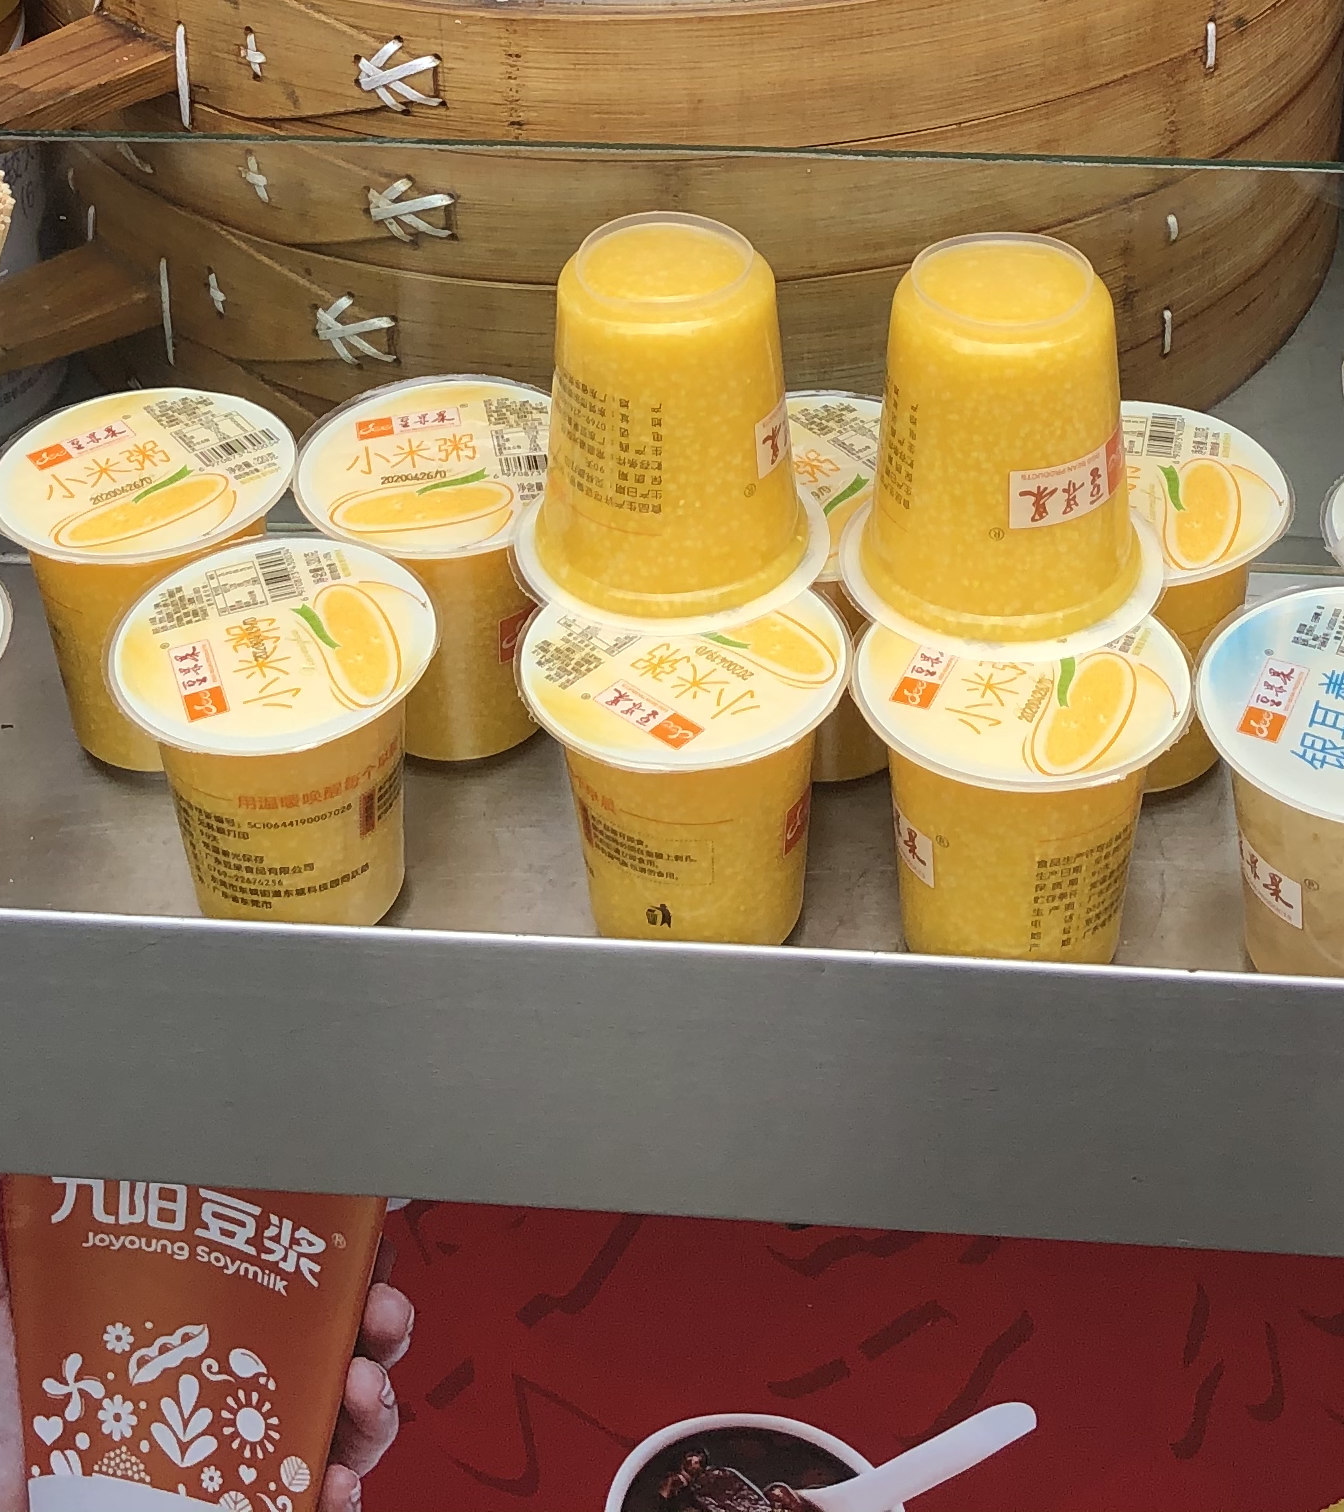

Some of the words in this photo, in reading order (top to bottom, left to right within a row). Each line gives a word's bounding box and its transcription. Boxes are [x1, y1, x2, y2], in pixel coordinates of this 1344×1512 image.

[45, 439, 171, 501] 小米粥
[345, 432, 478, 476] 小米粥
[223, 613, 303, 709] 小米粥
[630, 642, 761, 720] 小米粥
[50, 1176, 329, 1288] 九阳豆浆
[81, 1229, 191, 1261] Joyoung
[195, 1242, 289, 1297] Soymilk
